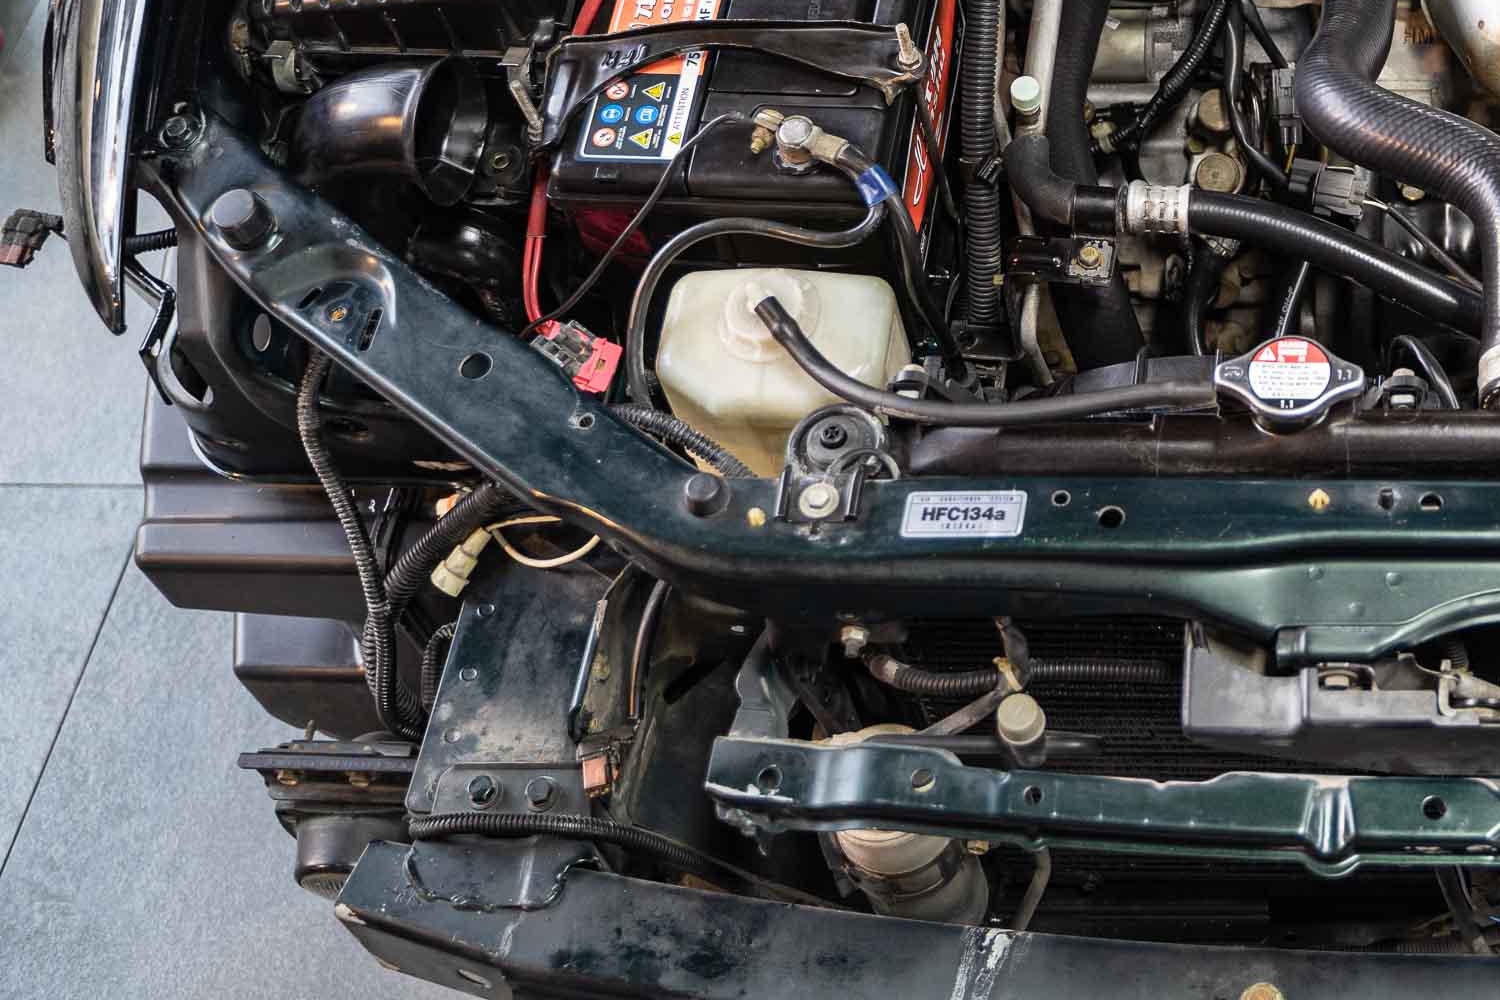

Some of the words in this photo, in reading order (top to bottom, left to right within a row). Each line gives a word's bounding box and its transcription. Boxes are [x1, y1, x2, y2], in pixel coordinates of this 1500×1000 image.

[672, 87, 689, 131] ATTENTION
[1280, 399, 1294, 409] 1.1
[921, 506, 1006, 521] HFC134a
